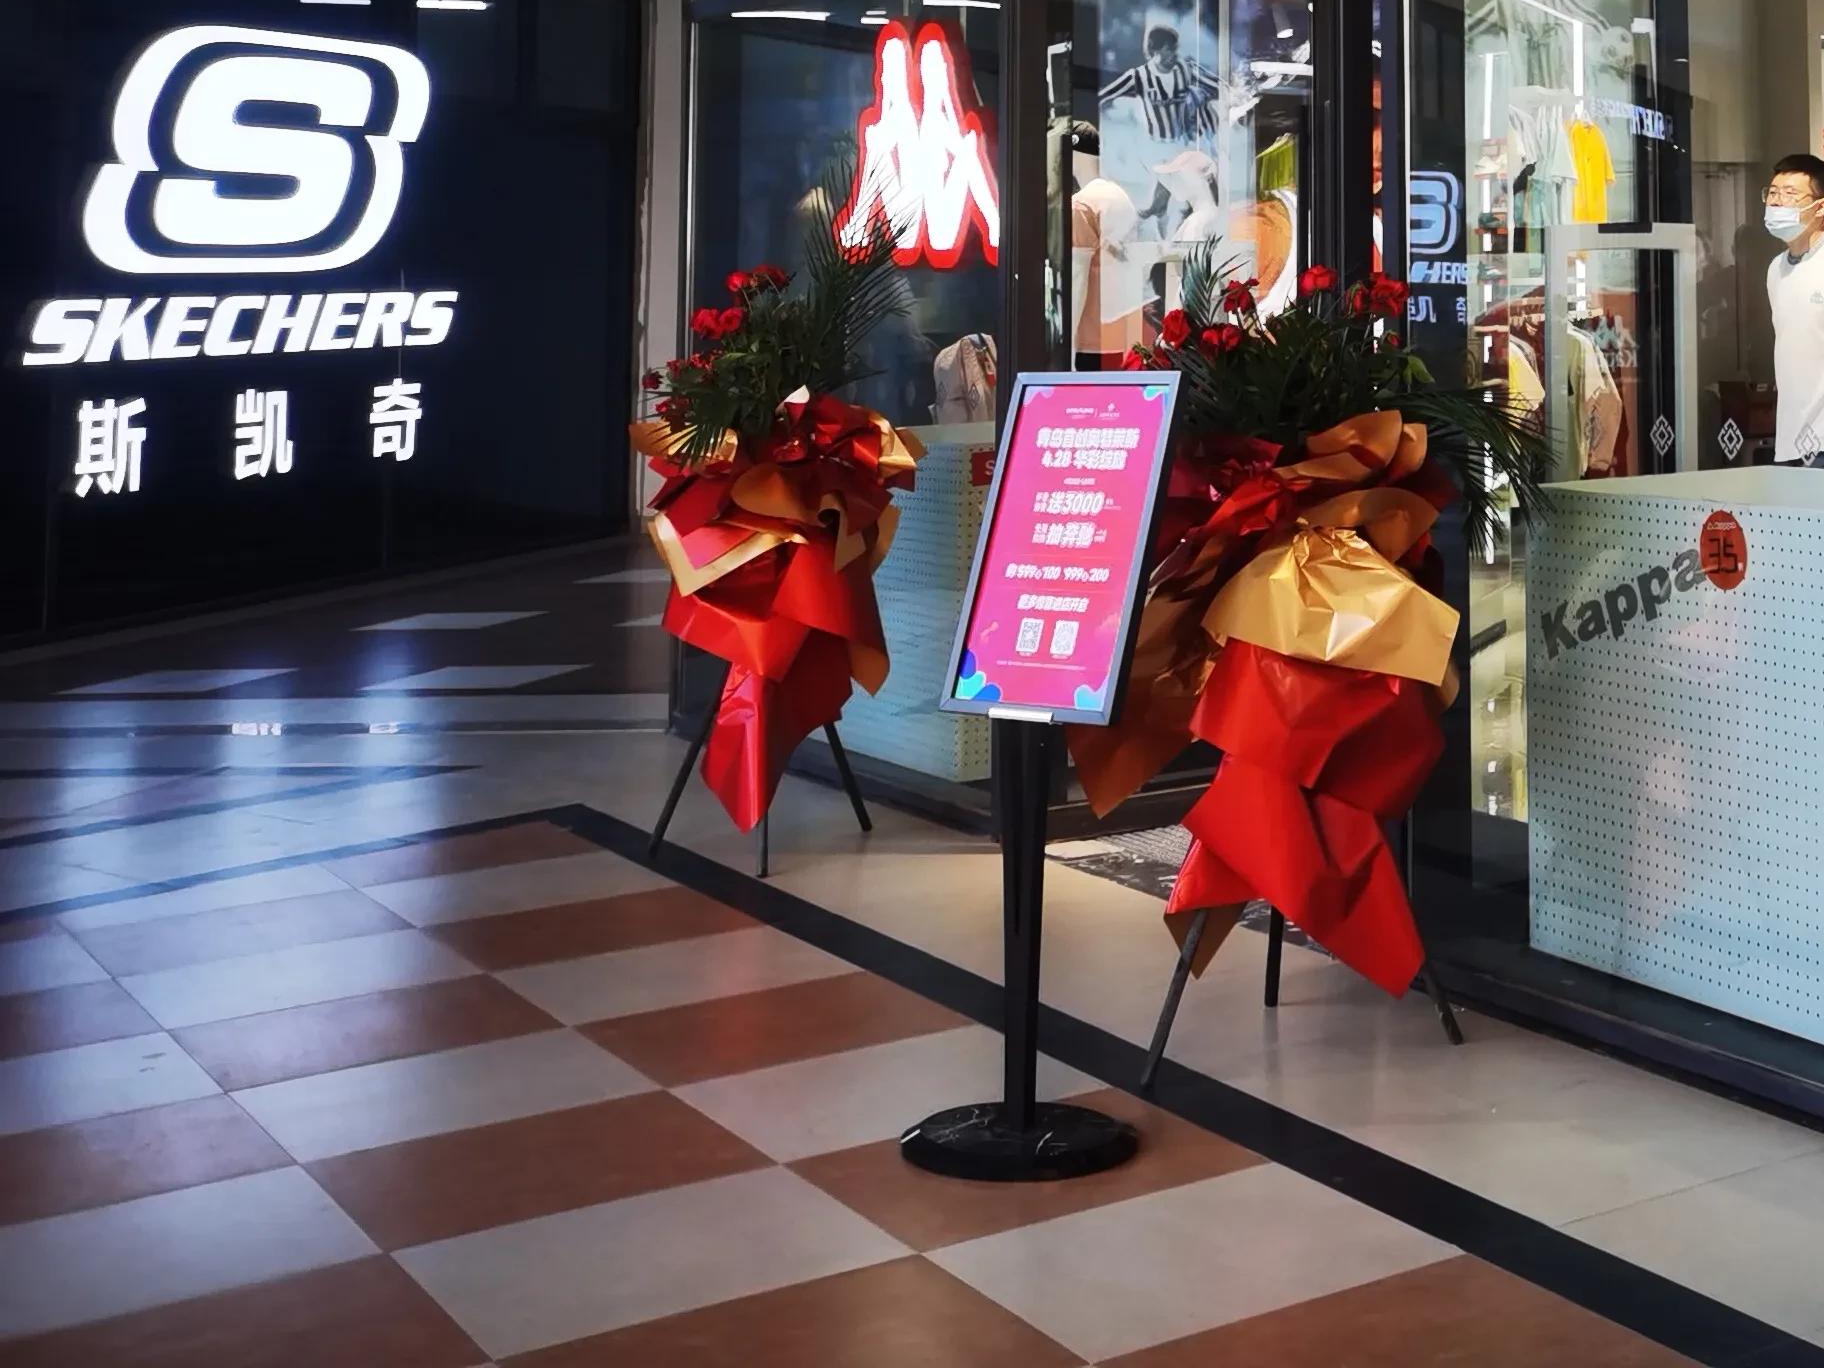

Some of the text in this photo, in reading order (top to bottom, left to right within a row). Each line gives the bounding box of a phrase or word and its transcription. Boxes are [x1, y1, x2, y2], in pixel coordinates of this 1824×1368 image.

[23, 290, 459, 367] SKECHERS
[73, 378, 423, 498] 斯凯奇
[1541, 548, 1707, 661] Kappa
